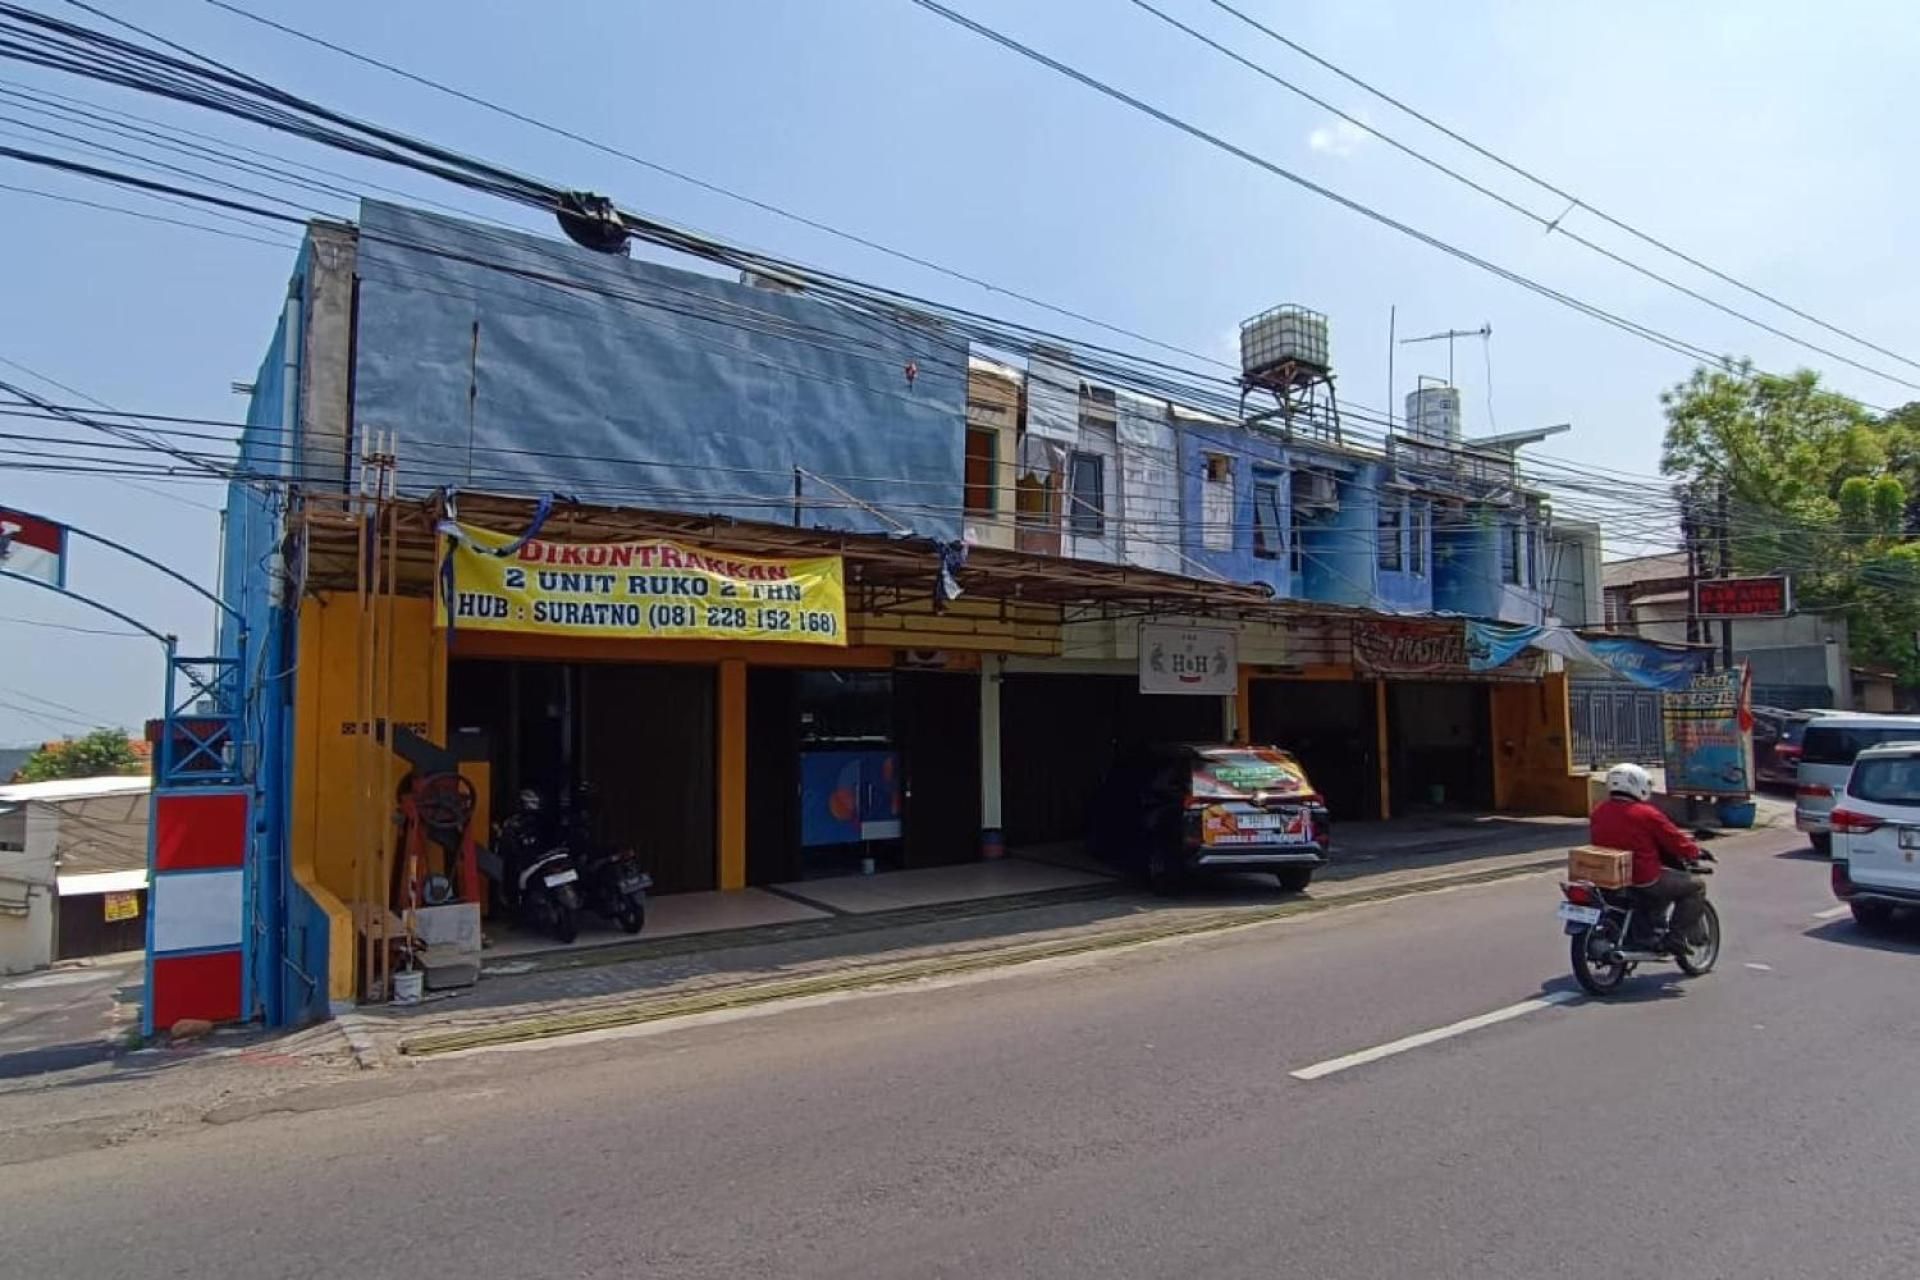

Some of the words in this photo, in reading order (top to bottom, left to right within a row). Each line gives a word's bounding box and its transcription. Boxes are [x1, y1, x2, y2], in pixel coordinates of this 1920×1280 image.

[518, 540, 788, 580] DIKONTRAKKAN
[506, 568, 525, 588] 2
[538, 570, 616, 593] UNIT
[628, 575, 709, 596] RUKO
[720, 581, 737, 597] 2
[457, 593, 509, 618] HUB
[533, 601, 640, 626] SURATNO
[650, 604, 696, 630] (081
[707, 606, 747, 628] 228
[757, 609, 791, 631] 152
[800, 611, 837, 637] 168)
